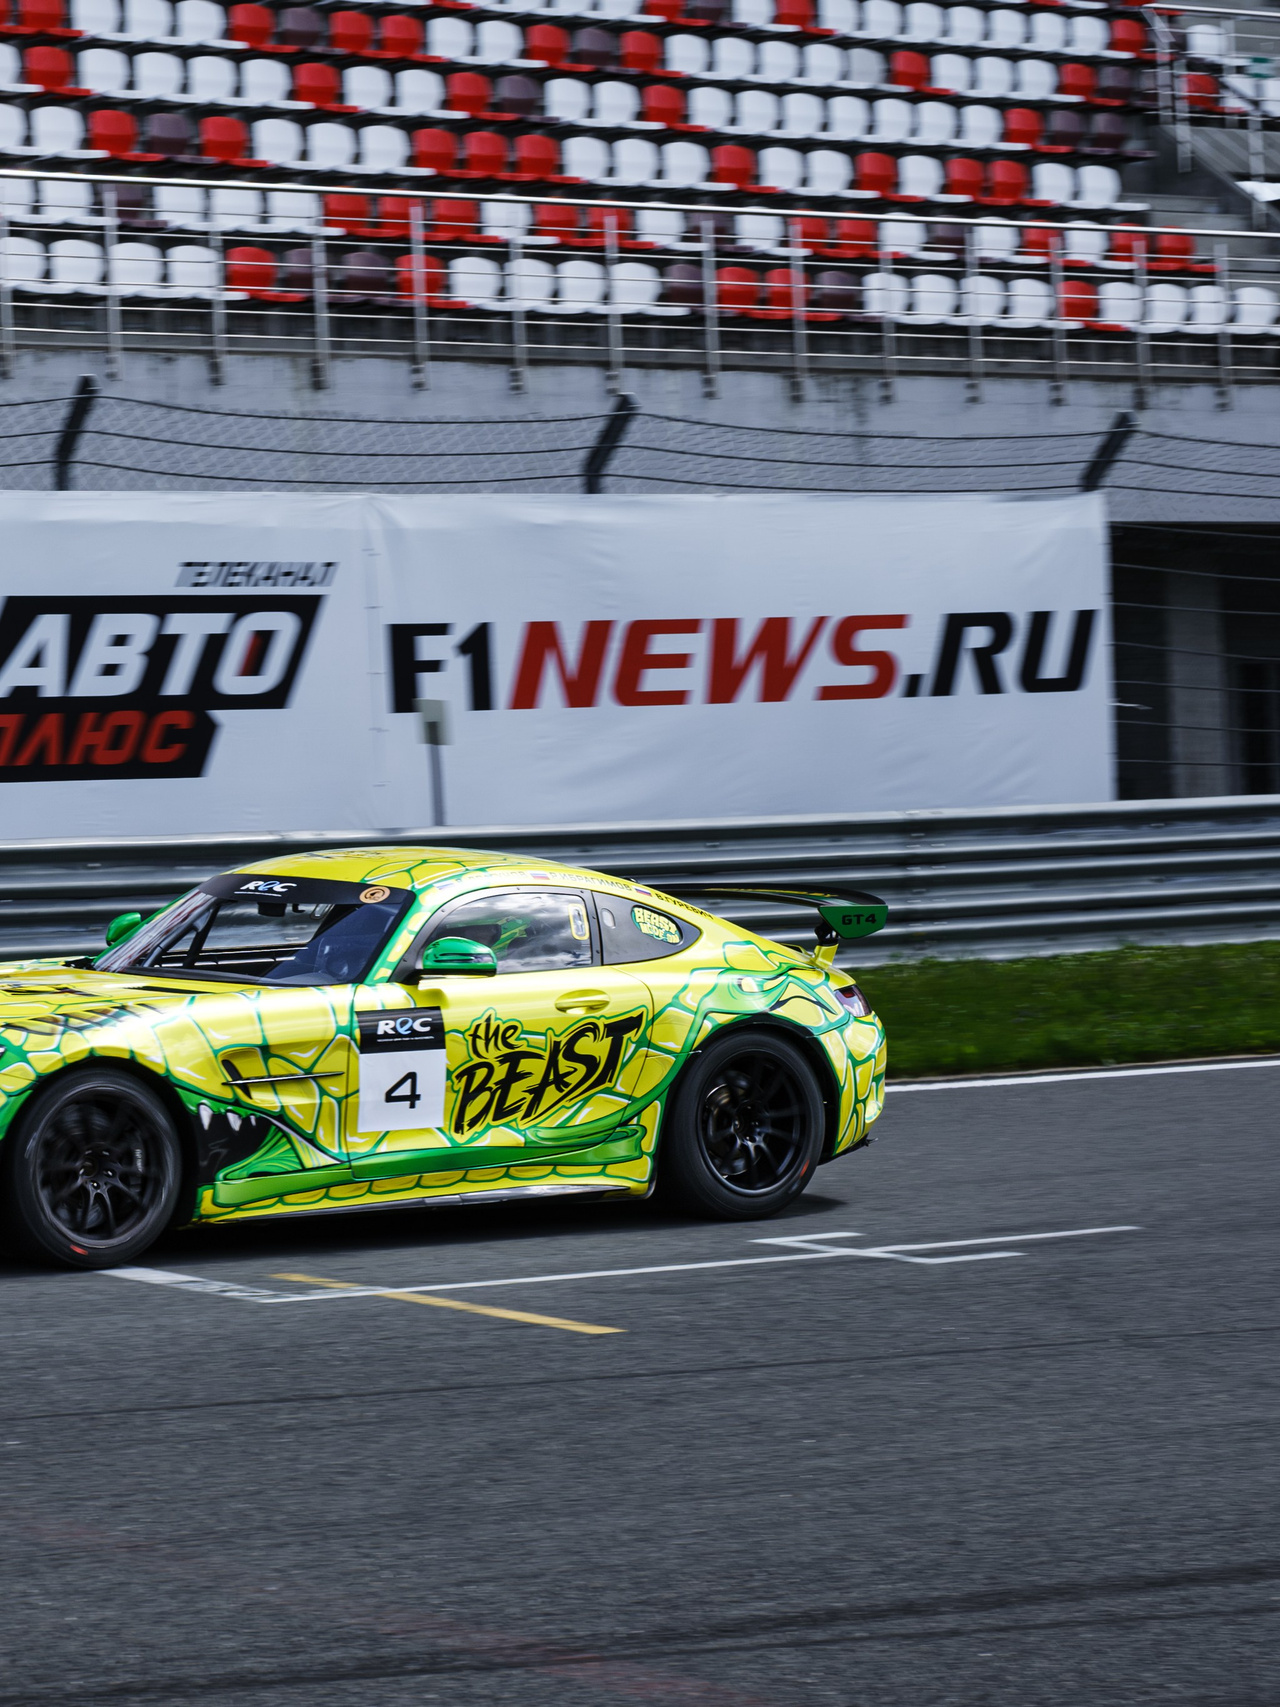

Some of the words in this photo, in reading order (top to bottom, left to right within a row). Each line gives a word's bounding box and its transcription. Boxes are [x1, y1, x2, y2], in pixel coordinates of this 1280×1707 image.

[174, 561, 340, 587] ТЕЛЕКАНАЛ
[387, 609, 1097, 714] F1NEWS.RU
[633, 907, 678, 935] BEAST
[842, 914, 876, 925] GT4
[468, 1014, 524, 1060] the
[385, 1071, 421, 1109] 4
[454, 1011, 644, 1135] BEAST
